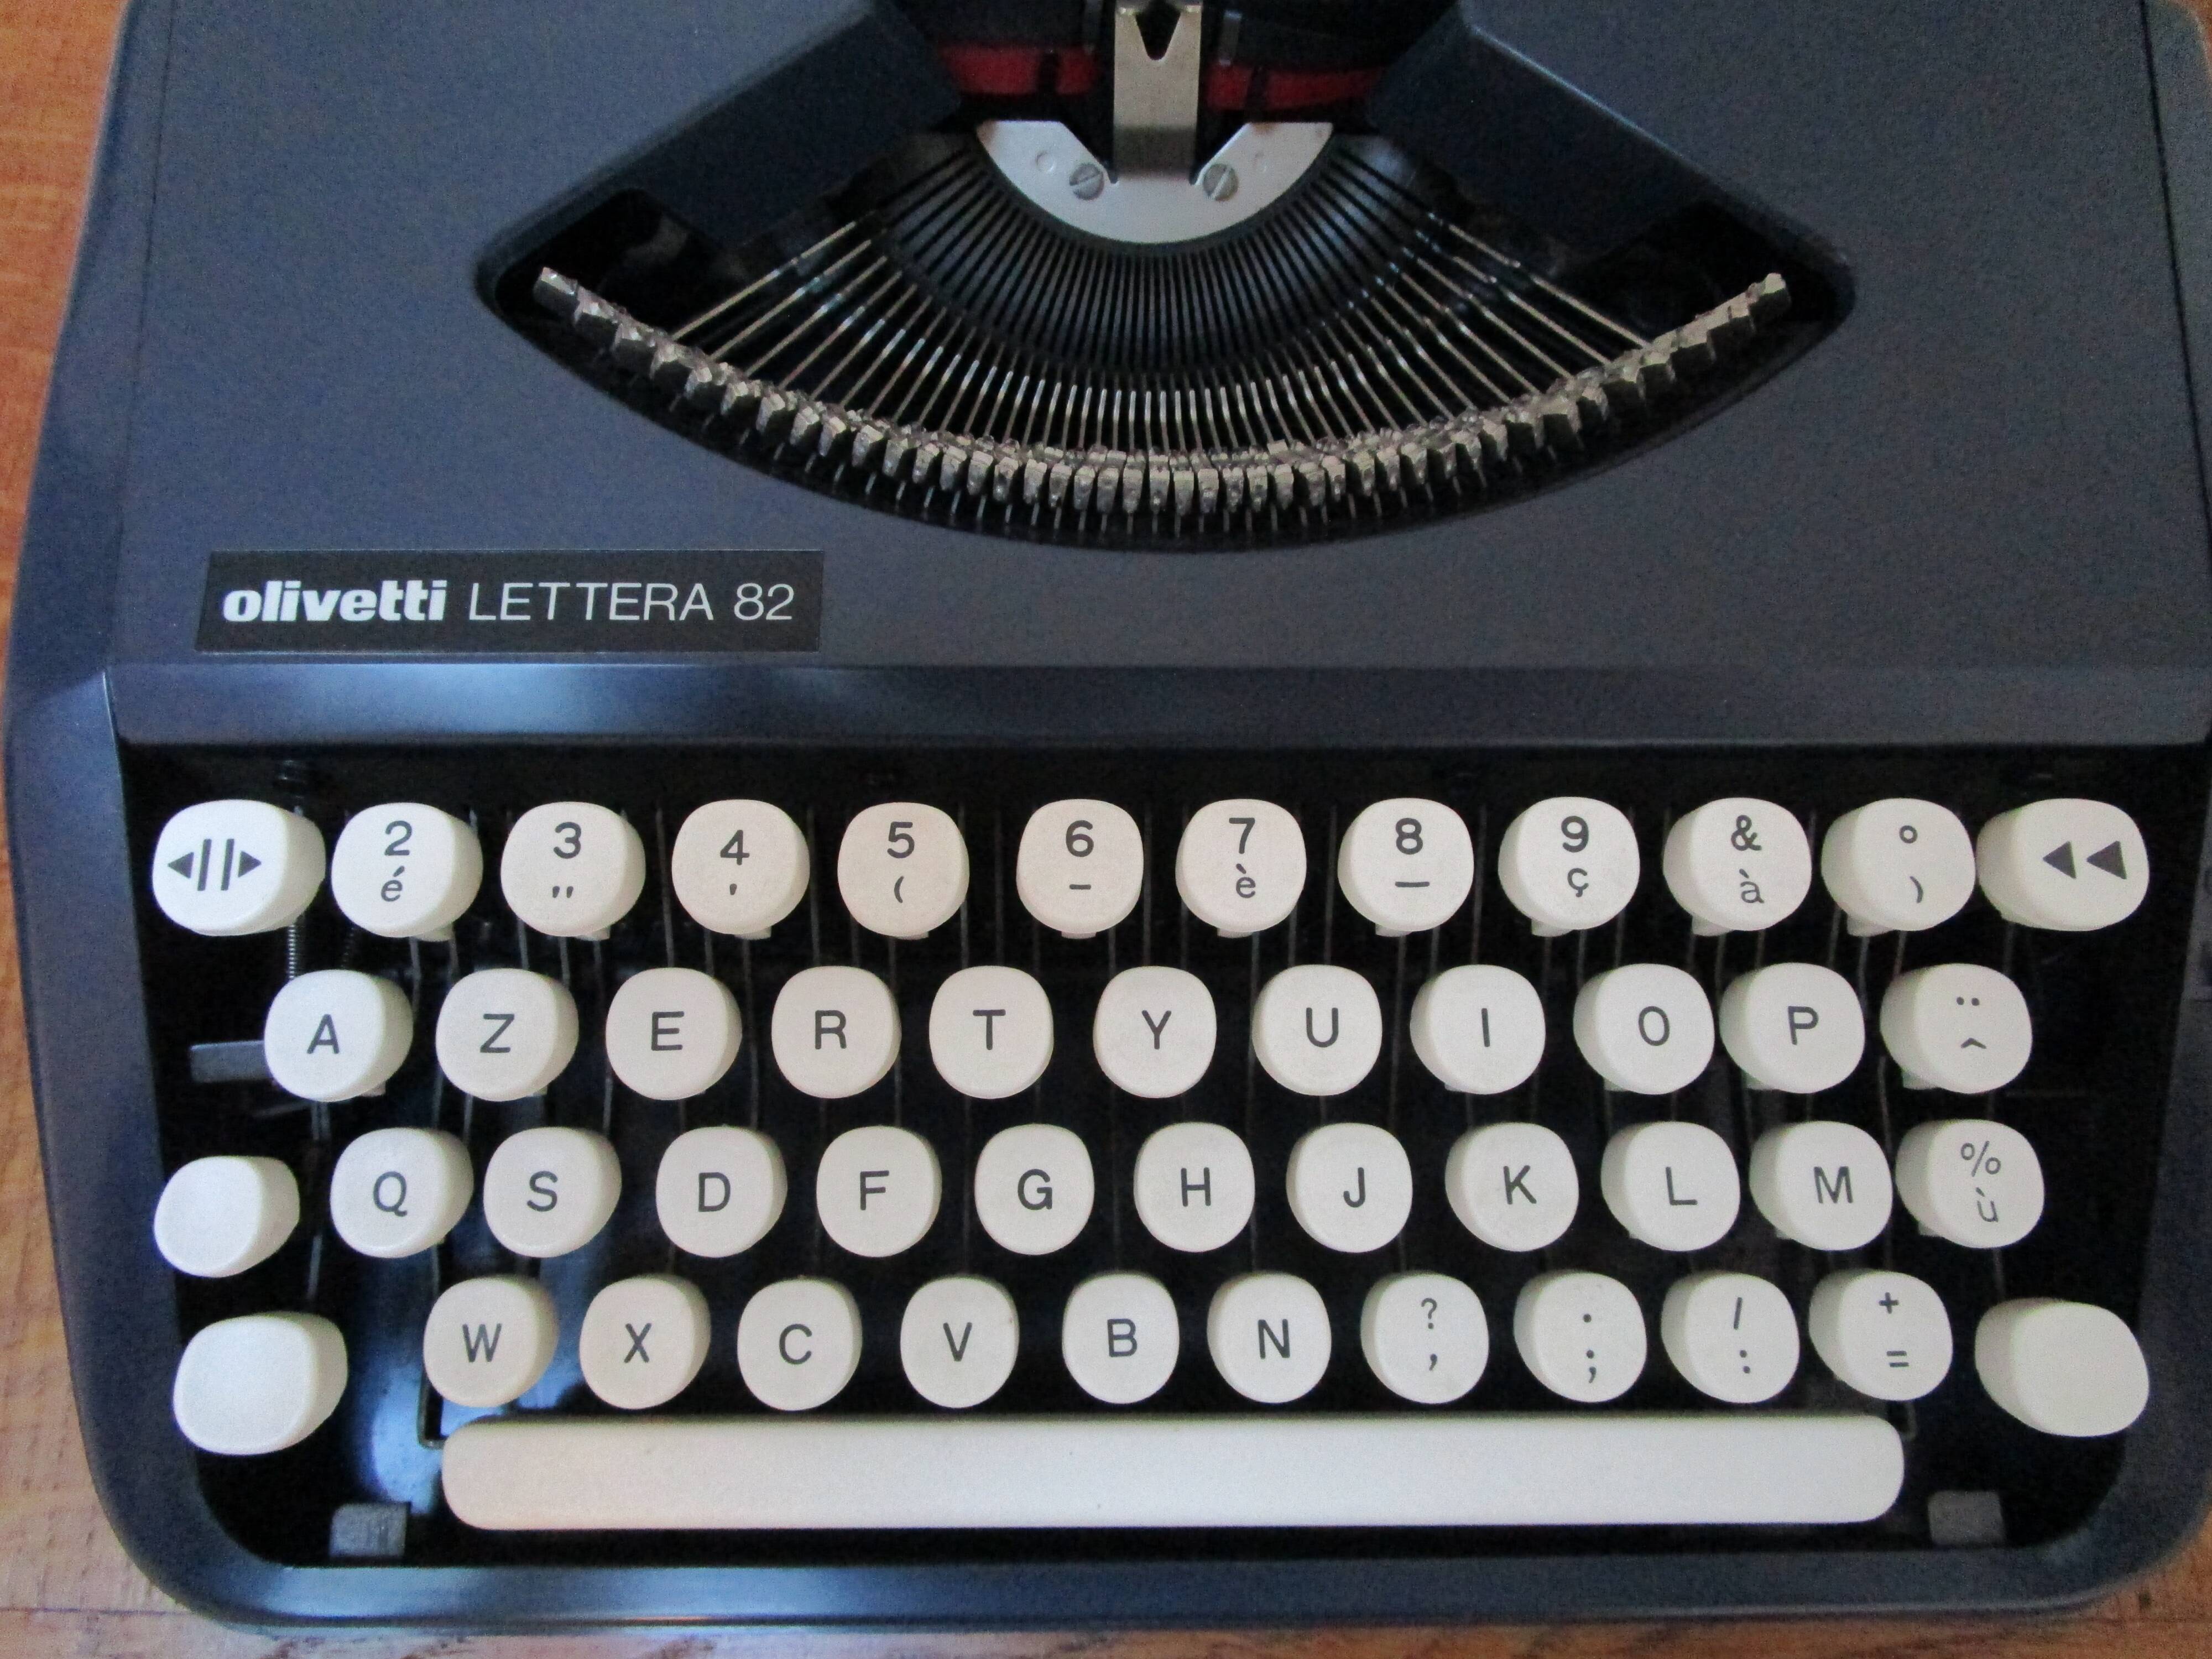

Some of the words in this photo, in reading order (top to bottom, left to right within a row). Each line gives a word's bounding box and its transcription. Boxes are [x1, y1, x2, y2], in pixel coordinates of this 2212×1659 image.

[222, 580, 447, 623] olivetti
[469, 582, 714, 621] LETTERA
[734, 582, 794, 620] 82
[384, 820, 413, 857] 2
[553, 821, 582, 860] 3
[719, 829, 750, 866] 4
[886, 821, 915, 859] 5
[1065, 820, 1094, 858] 6
[1228, 817, 1256, 855] 7
[1395, 817, 1423, 855] 8
[1561, 815, 1589, 853] 9
[1730, 814, 1762, 852] &
[380, 865, 405, 902] é
[893, 875, 904, 904] (
[1235, 863, 1256, 899] è
[1567, 867, 1589, 898] ç
[1739, 868, 1765, 904] à
[1910, 876, 1924, 904] )
[306, 1014, 340, 1055] A
[479, 1013, 515, 1054] Z
[650, 1010, 685, 1052] E
[815, 1009, 847, 1050] R
[972, 1009, 1006, 1051] T
[1141, 1010, 1172, 1050] Y
[1305, 1006, 1339, 1048] U
[1480, 1008, 1491, 1048] I
[1637, 1005, 1671, 1047] O
[1787, 1005, 1819, 1046] P
[1960, 1141, 2001, 1177] %
[372, 1171, 408, 1218] Q
[526, 1170, 558, 1213] S
[698, 1171, 731, 1213] D
[859, 1170, 890, 1211] F
[1017, 1168, 1053, 1211] G
[1180, 1167, 1212, 1207] H
[1343, 1166, 1366, 1208] J
[1503, 1165, 1537, 1206] K
[1665, 1166, 1698, 1206] L
[1813, 1166, 1854, 1204] M
[1975, 1187, 1999, 1223] ù
[1421, 1297, 1438, 1329] ?
[1879, 1292, 1900, 1314] +
[462, 1323, 502, 1363] W
[623, 1323, 652, 1364] X
[778, 1323, 812, 1365] C
[942, 1322, 973, 1362] V
[1107, 1318, 1138, 1358] B
[1257, 1318, 1291, 1360] N
[1585, 1349, 1597, 1384] ;
[1739, 1349, 1751, 1374] :
[1886, 1350, 1910, 1368] =
